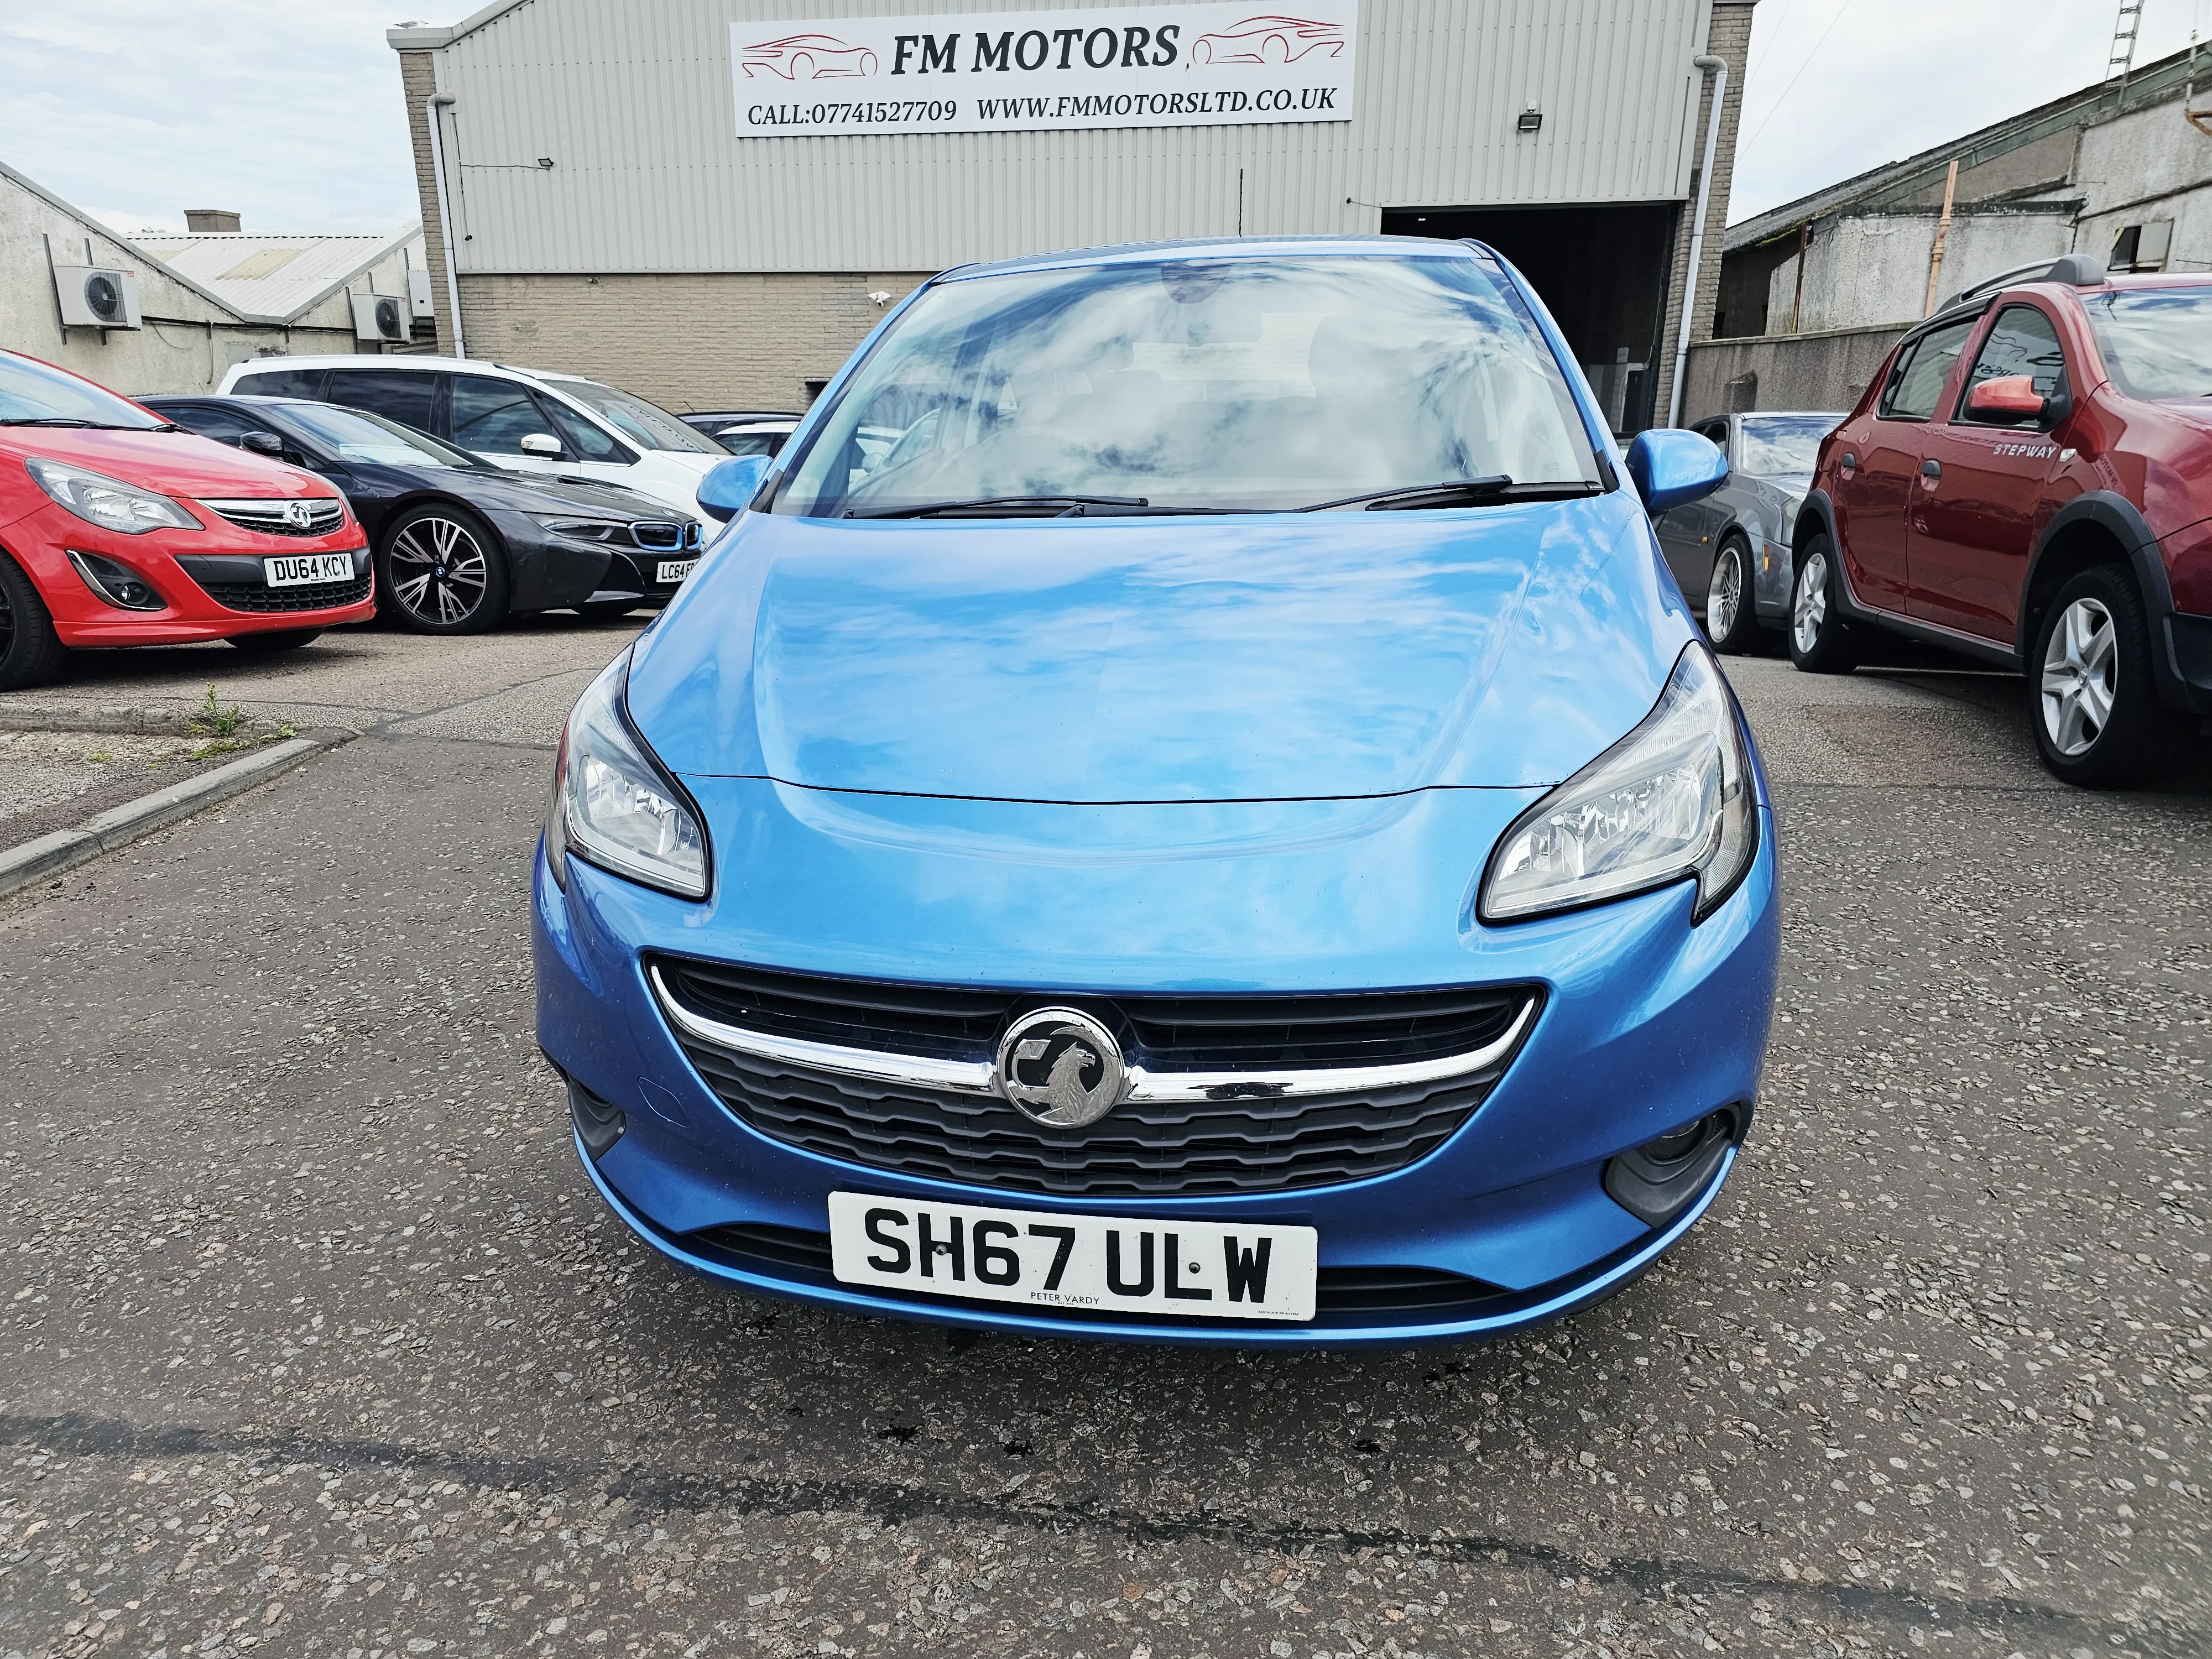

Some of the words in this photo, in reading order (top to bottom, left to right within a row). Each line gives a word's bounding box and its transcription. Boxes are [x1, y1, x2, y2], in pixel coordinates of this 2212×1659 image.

[891, 34, 960, 75] FM
[971, 25, 1180, 72] MOTORS
[748, 101, 957, 125] CALL:07741527709
[977, 88, 1337, 119] WWW.FMMOTORSLTD.CO.UK
[1993, 444, 2057, 458] STEPWAY
[273, 558, 319, 581] DU64
[322, 556, 346, 577] KCY
[661, 564, 685, 579] LC64
[865, 1208, 1075, 1291] SH67
[1107, 1230, 1272, 1303] ULW
[1031, 1292, 1060, 1301] PETER
[1065, 1295, 1099, 1305] VARDY
